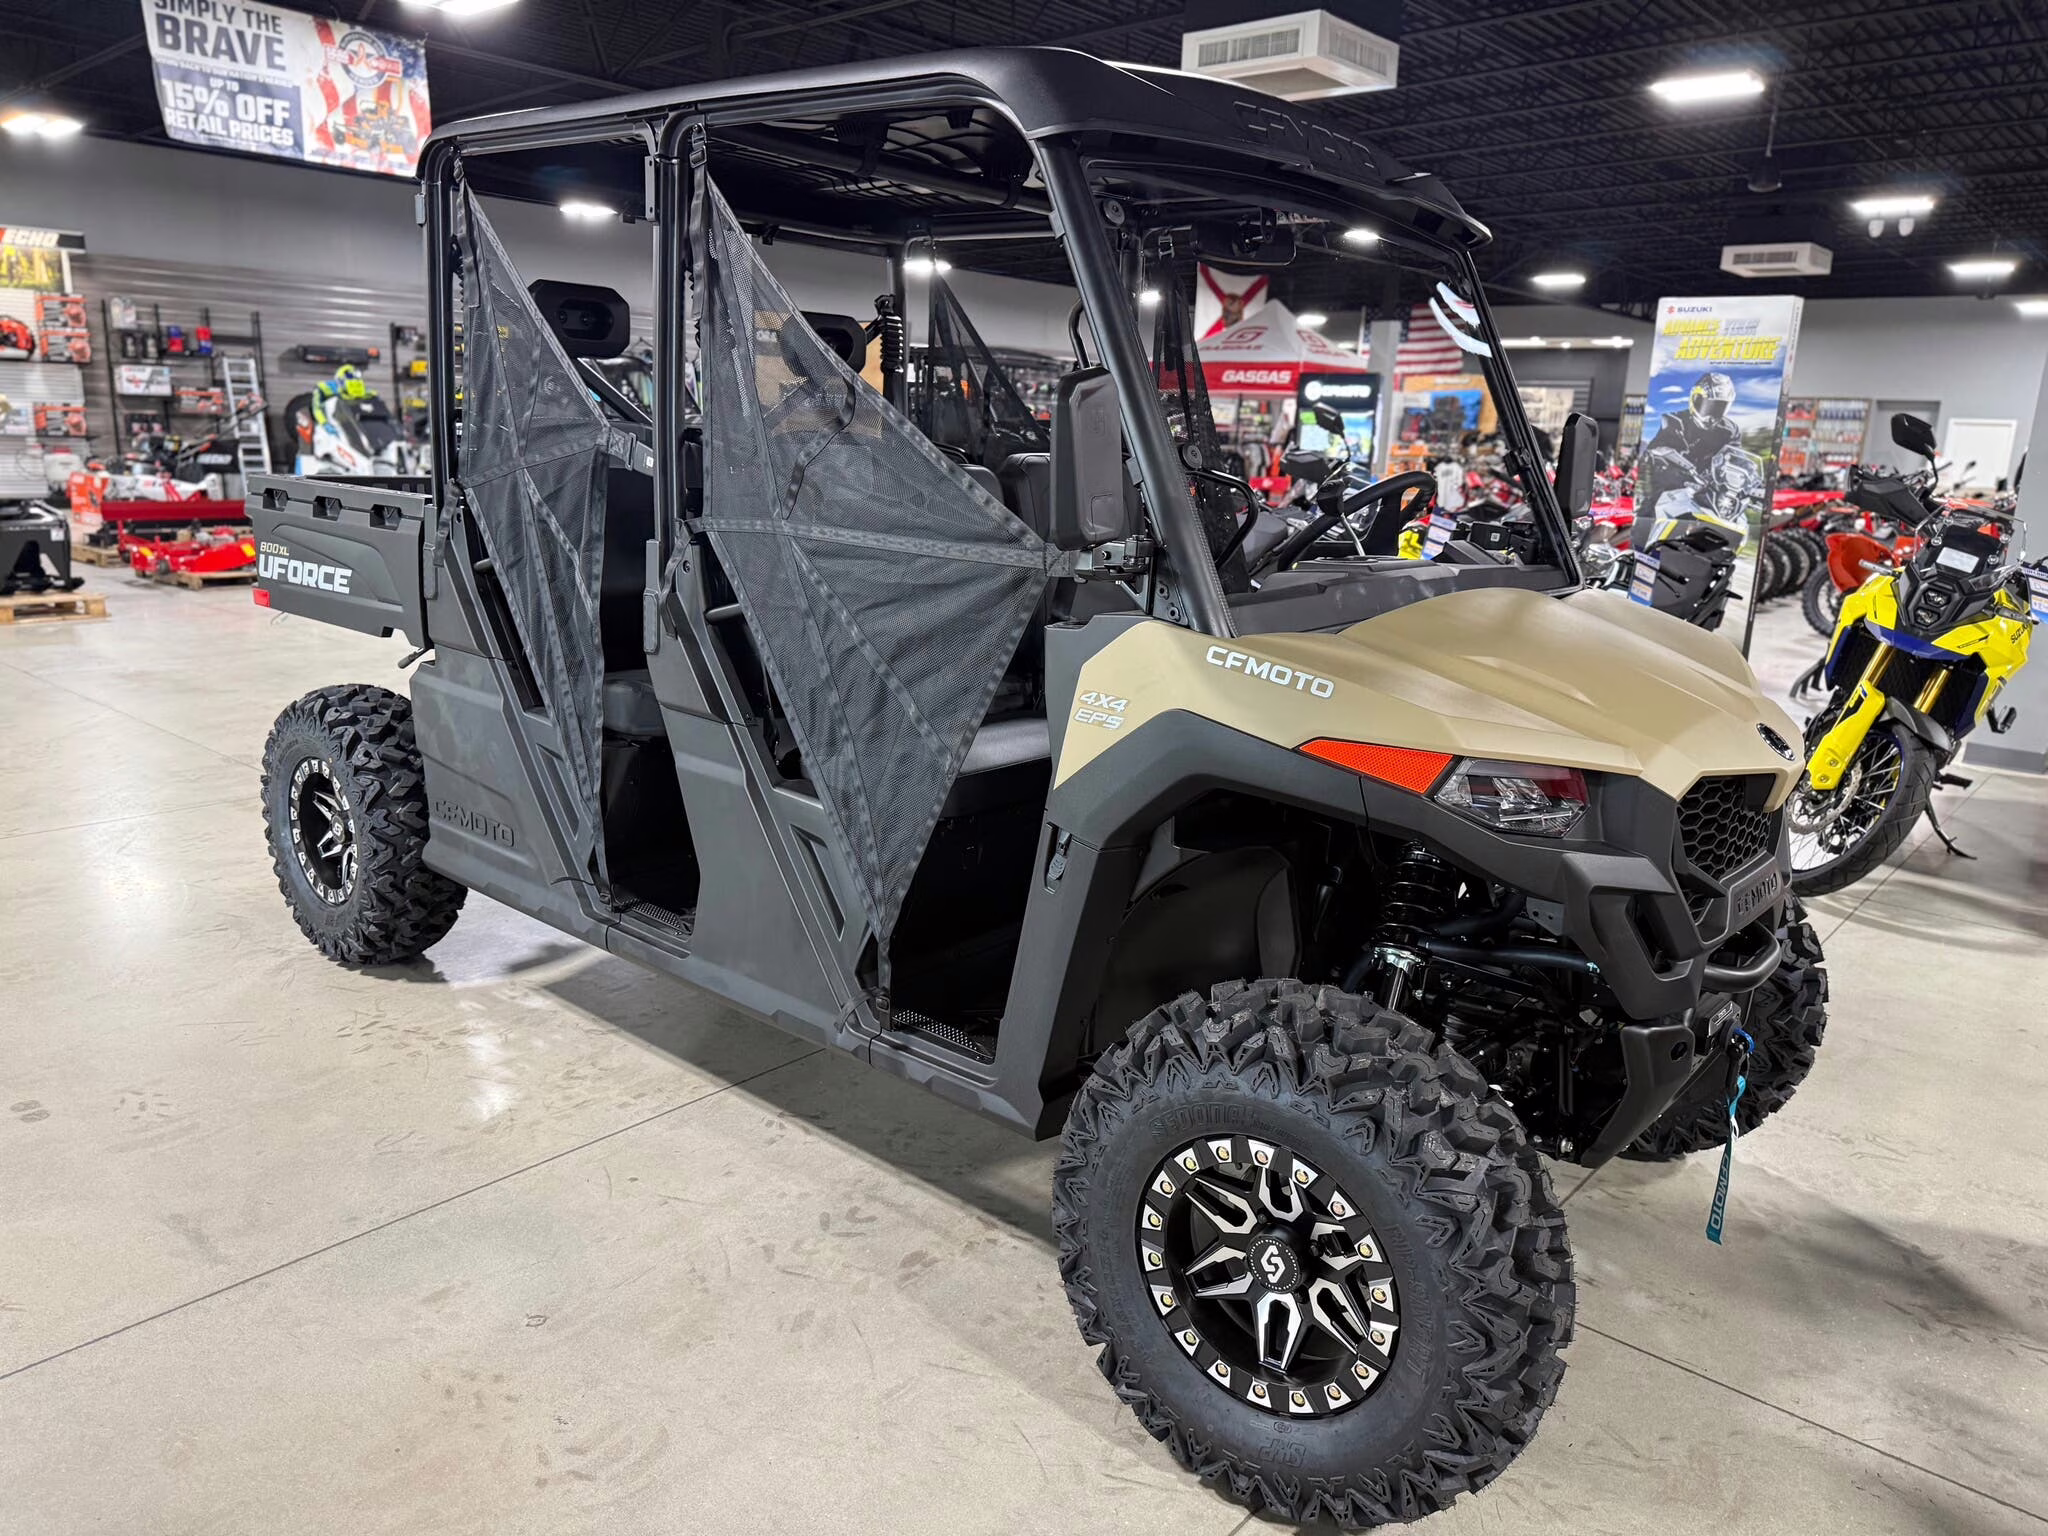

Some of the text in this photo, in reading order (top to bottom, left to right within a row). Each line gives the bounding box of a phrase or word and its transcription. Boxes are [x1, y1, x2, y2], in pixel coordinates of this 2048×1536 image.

[243, 8, 283, 35] THE
[155, 12, 287, 71] BRAVE
[209, 76, 240, 93] UP TO
[161, 78, 291, 127] 15% OFF
[164, 106, 228, 137] RETAIL
[229, 120, 295, 147] PRICES
[3, 228, 60, 249] ECHO
[1676, 306, 1713, 314] SUZUKI
[1674, 335, 1782, 361] ADVENTURE
[1221, 369, 1292, 385] GASGAS
[258, 553, 353, 595] UFORCE
[1205, 645, 1335, 699] CFMOTO
[1079, 691, 1129, 713] 4X4
[1073, 708, 1125, 731] EPS
[435, 800, 515, 848] CFMOTO
[1736, 871, 1778, 916] CFMOTO
[1710, 1153, 1729, 1231] CFMOTO
